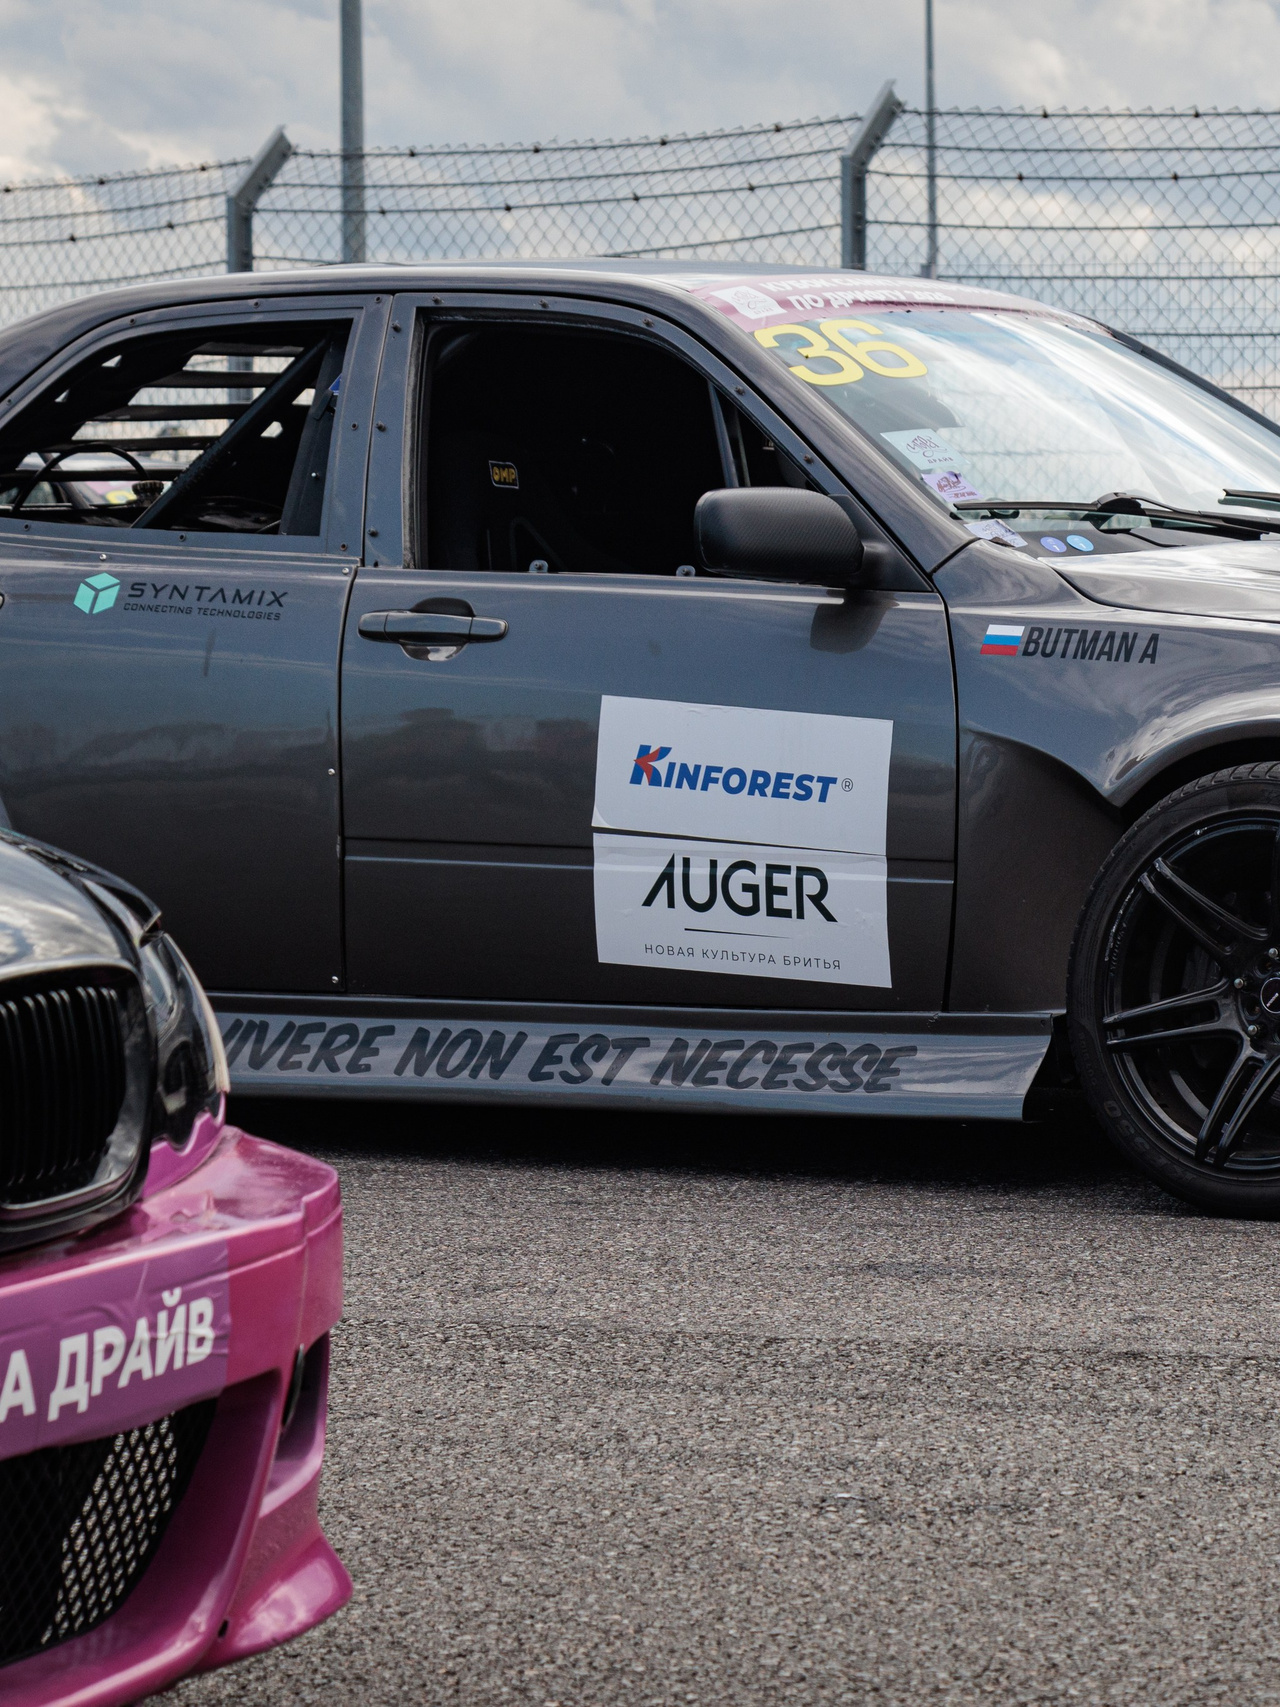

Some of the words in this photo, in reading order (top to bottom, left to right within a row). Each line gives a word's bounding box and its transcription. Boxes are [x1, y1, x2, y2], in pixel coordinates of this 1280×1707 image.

[787, 293, 824, 311] ПО
[754, 319, 928, 387] 36
[492, 465, 516, 483] OMP
[123, 602, 193, 615] CONNECTING
[197, 606, 281, 621] TECHNOLOGIES
[128, 582, 288, 607] SYNTAMIX
[1021, 626, 1138, 664] BUTMAN
[1138, 633, 1160, 664] A
[629, 744, 838, 804] KINFOREST
[641, 852, 838, 923] AUGER
[644, 943, 695, 958] НОВАЯ
[702, 948, 777, 965] КУЛЬТУРА
[783, 954, 841, 971] БРИТЬЯ
[393, 1026, 528, 1081] NON
[527, 1033, 651, 1087] EST
[651, 1037, 918, 1094] NECESSE
[0, 1349, 36, 1423] А
[48, 1286, 215, 1422] ДРАЙВ
